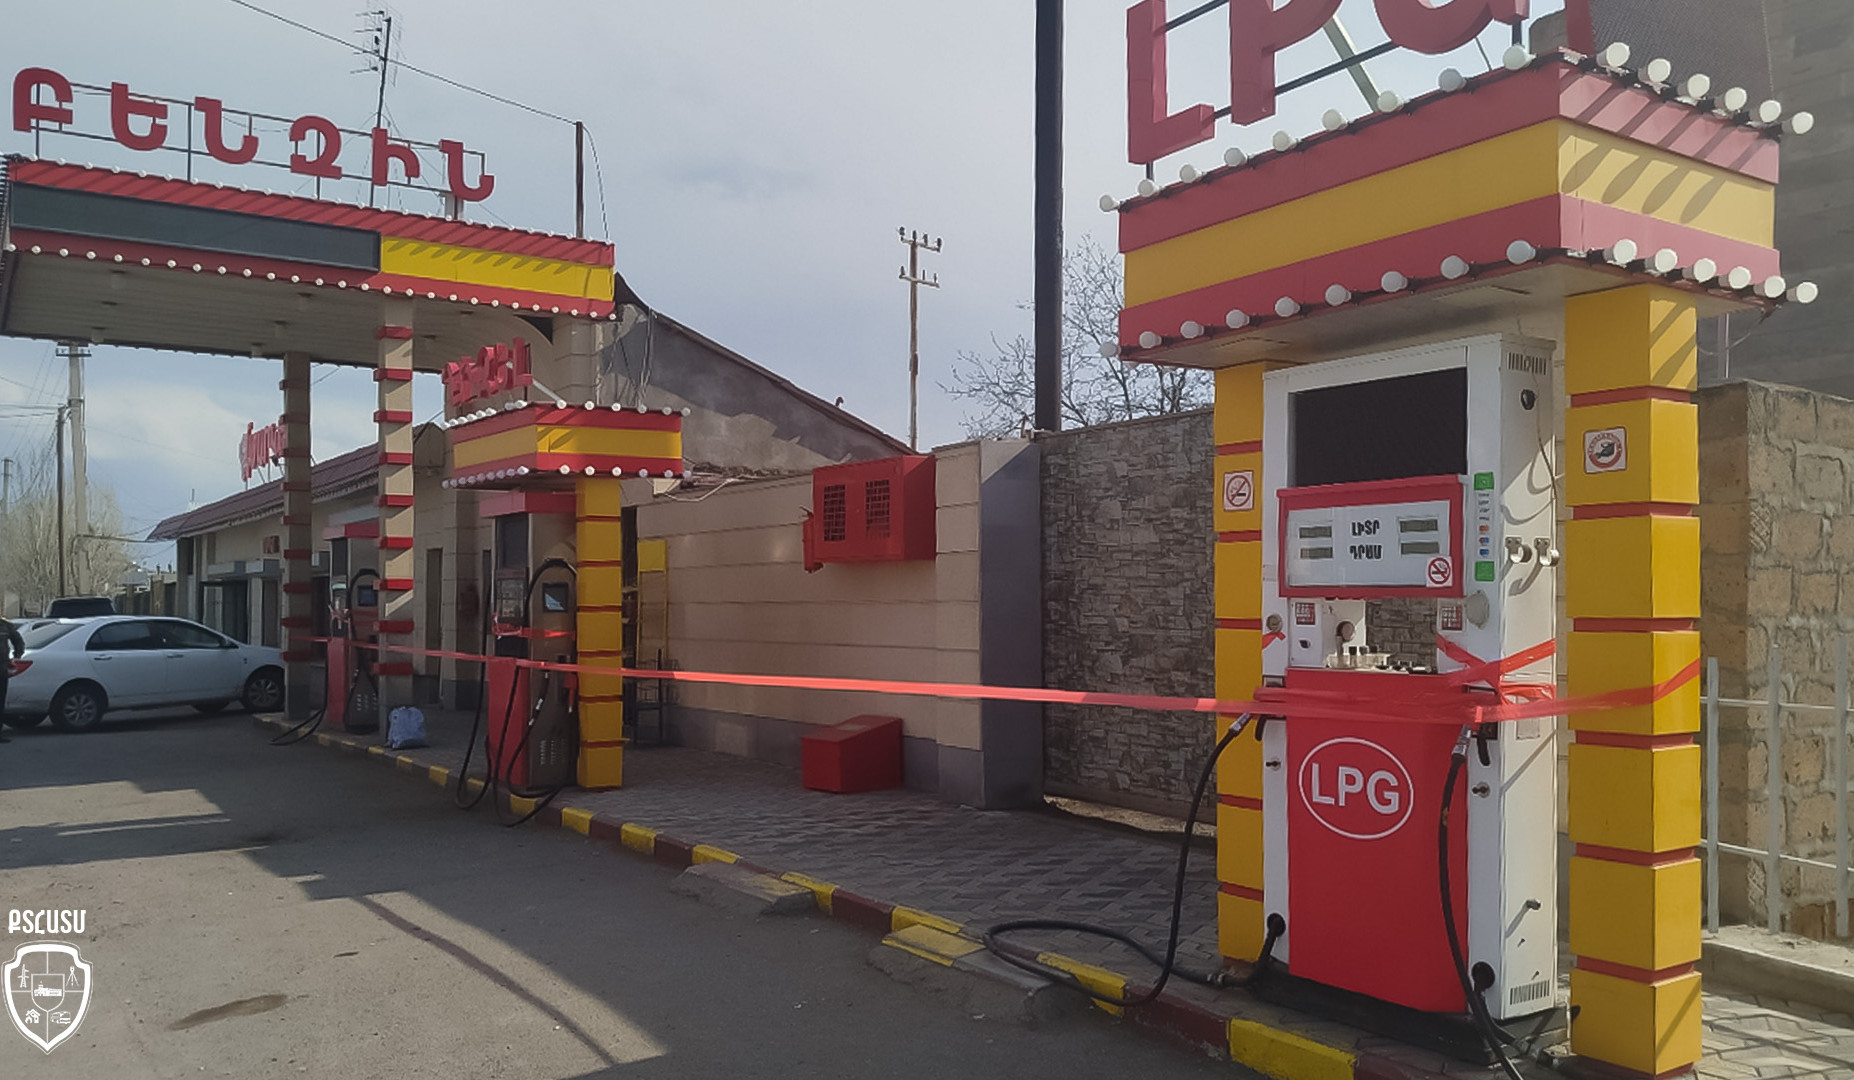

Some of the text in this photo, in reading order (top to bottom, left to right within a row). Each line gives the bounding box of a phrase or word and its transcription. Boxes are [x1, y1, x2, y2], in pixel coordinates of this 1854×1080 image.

[1127, 0, 1530, 164] LP
[12, 66, 495, 202] ԲԵՆԶԻՆ
[1349, 544, 1383, 560] ԴՐԱՄ
[1351, 519, 1380, 536] ԼԻՏՐ
[1310, 762, 1400, 815] LPG
